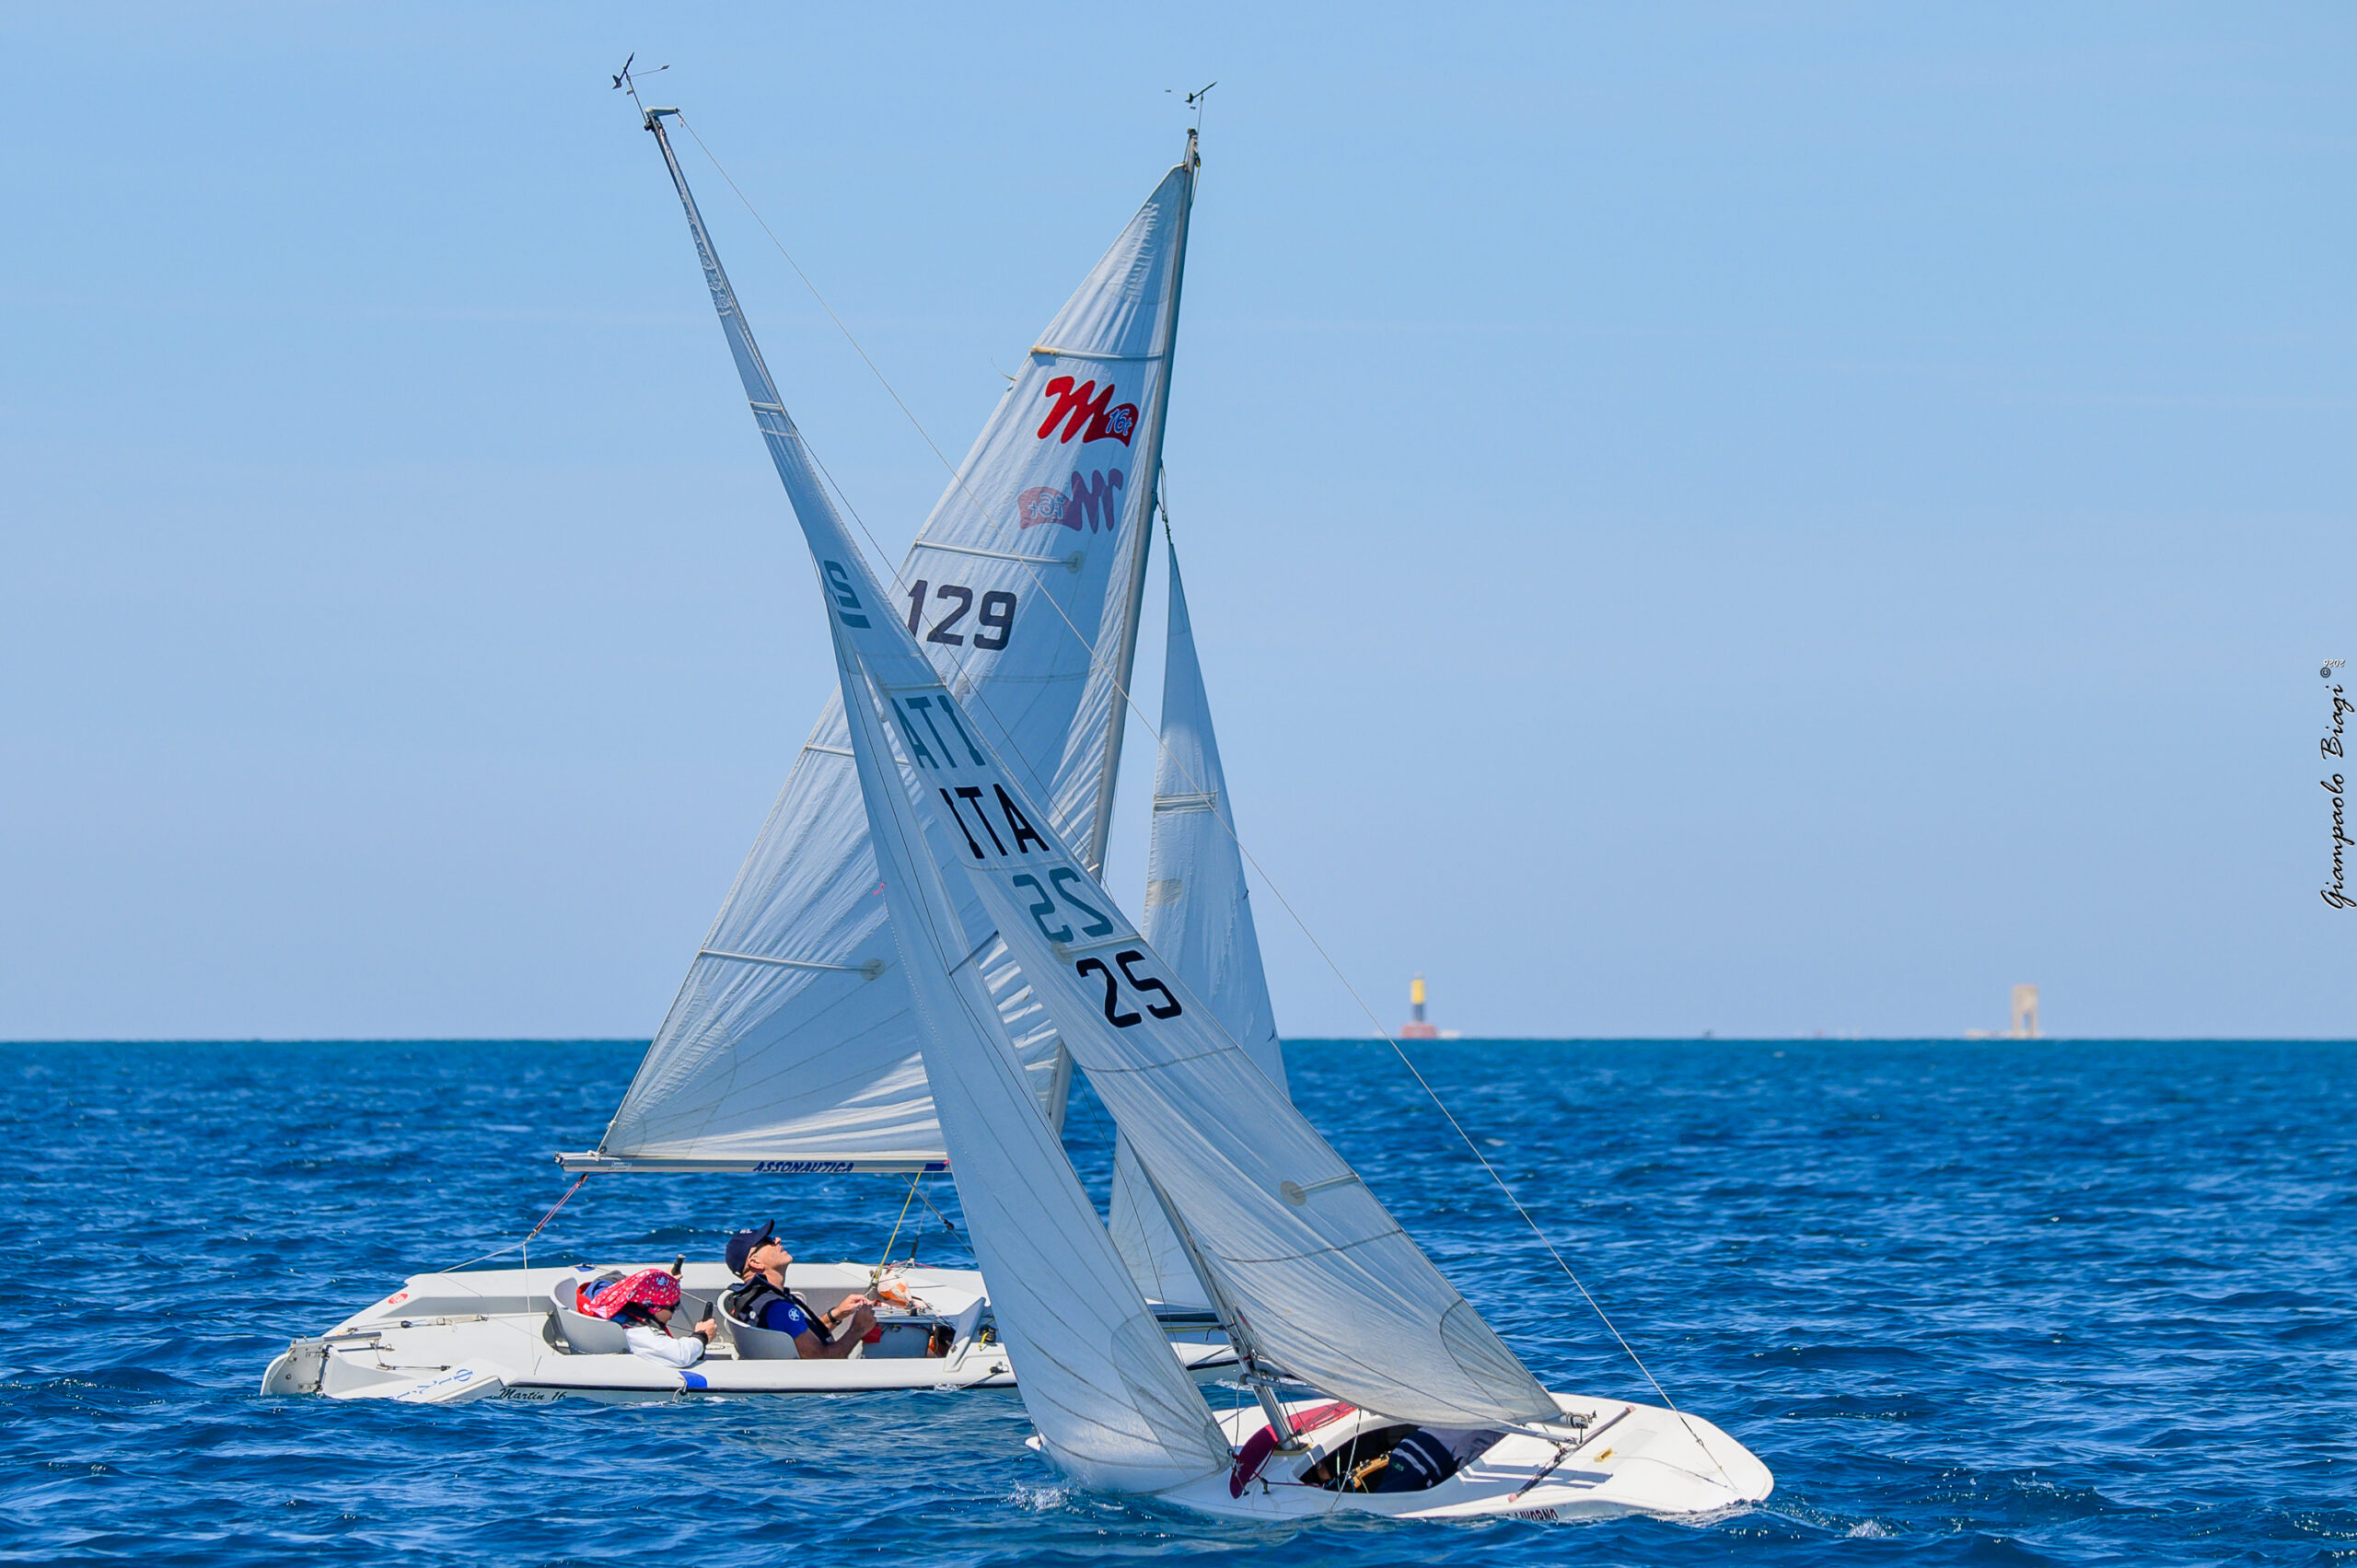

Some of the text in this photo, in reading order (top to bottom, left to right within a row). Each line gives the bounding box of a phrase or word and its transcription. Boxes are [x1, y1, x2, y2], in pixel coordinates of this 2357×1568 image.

[908, 579, 1017, 651] 129
[938, 784, 1051, 860] ITA
[1075, 950, 1183, 1028] 25
[752, 1161, 855, 1172] ASSONAUTICA
[499, 1388, 545, 1400] Martin
